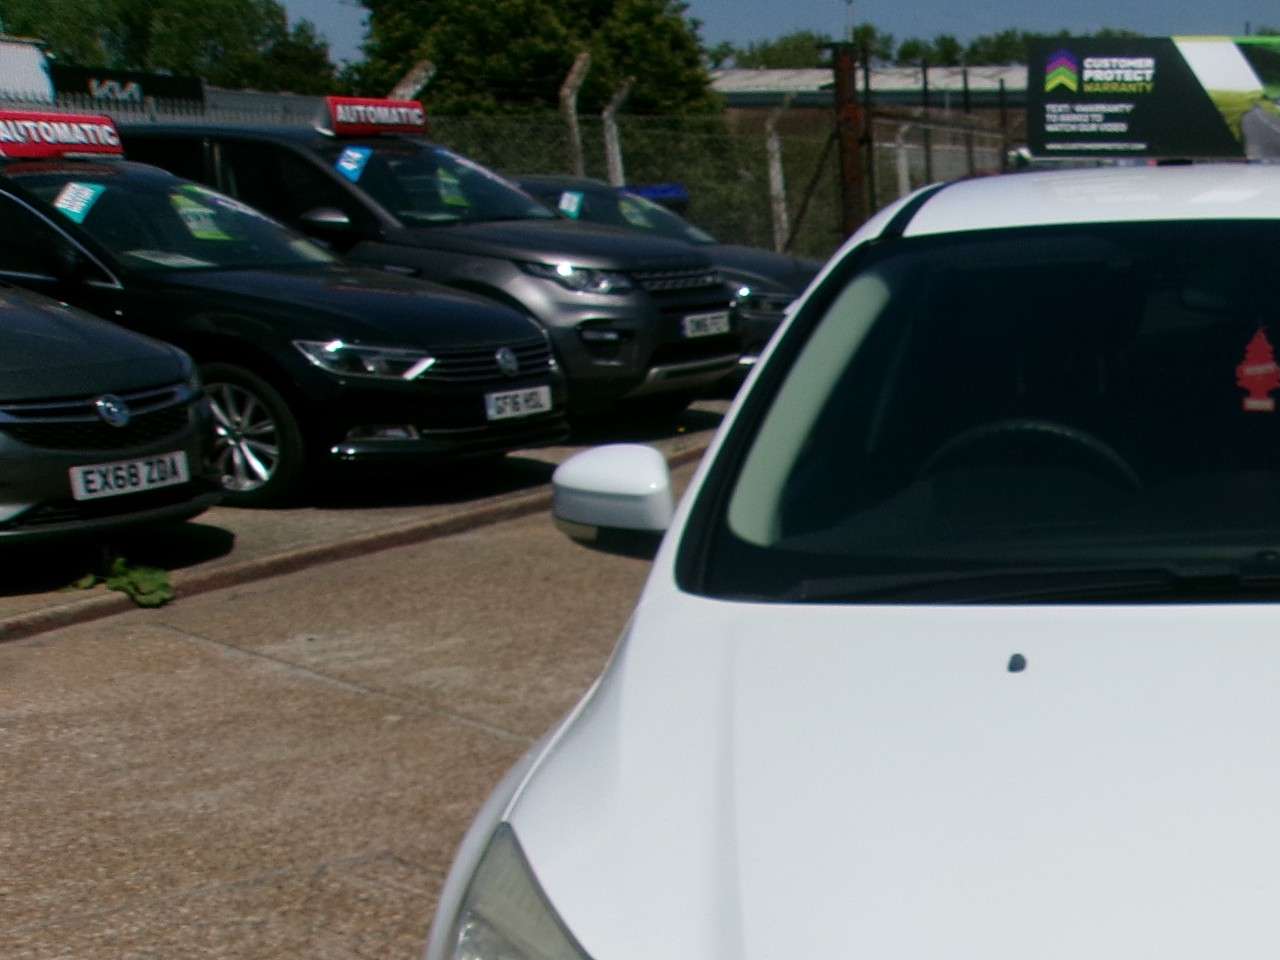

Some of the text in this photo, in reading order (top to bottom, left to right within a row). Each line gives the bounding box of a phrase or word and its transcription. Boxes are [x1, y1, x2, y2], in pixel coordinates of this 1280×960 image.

[1083, 58, 1155, 69] CUSTOMER
[1083, 69, 1155, 81] PROTECT
[1083, 82, 1153, 92] WARRANTY
[336, 104, 425, 126] AUTOMATIC
[0, 119, 120, 146] AUTOMATIC
[82, 464, 140, 494] EX68
